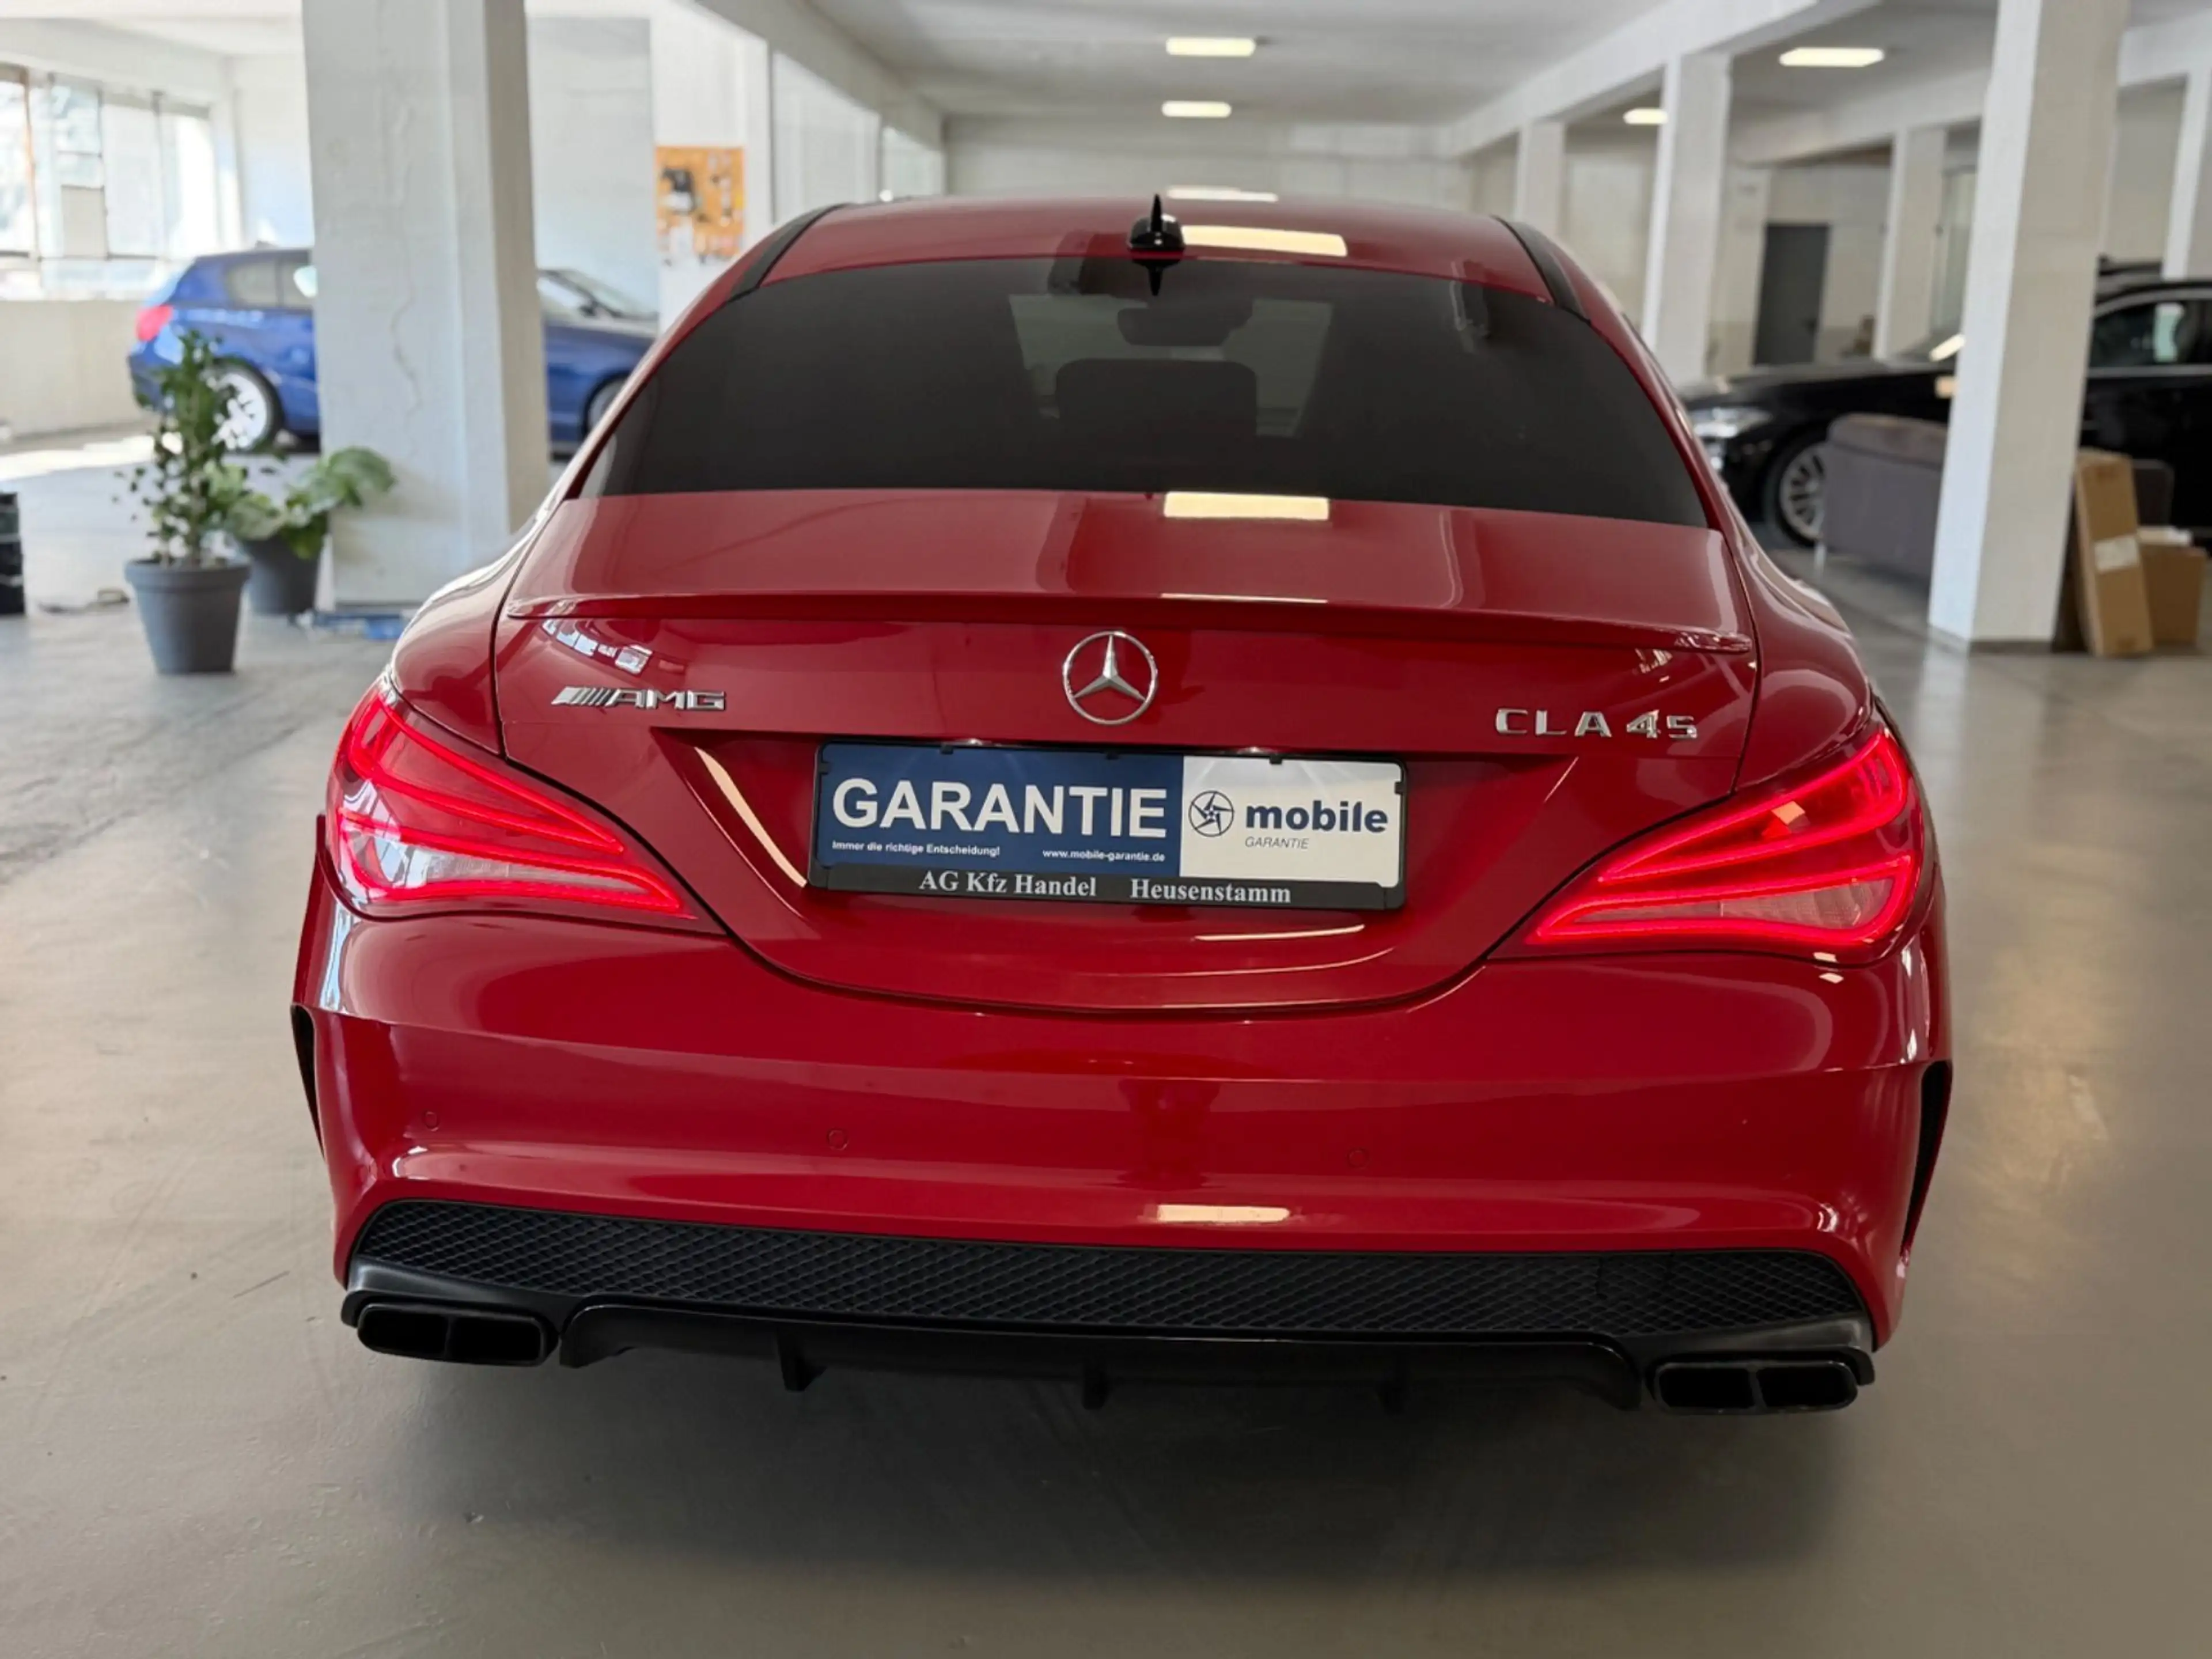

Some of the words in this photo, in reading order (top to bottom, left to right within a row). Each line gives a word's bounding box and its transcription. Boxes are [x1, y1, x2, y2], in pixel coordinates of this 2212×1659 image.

[605, 688, 727, 711] AMG
[1495, 707, 1612, 738] CLA
[1626, 709, 1698, 739] 45
[832, 778, 1167, 838] GARANTIE
[1245, 800, 1388, 833] mobile
[832, 840, 864, 851] Immer
[866, 842, 882, 851] die
[885, 842, 925, 855] richtige
[926, 843, 1000, 858] Entscheidung!
[1042, 849, 1165, 862] www.mobile-garantie.de
[1245, 836, 1309, 850] GARANTIE
[919, 870, 960, 892] AG
[966, 872, 1007, 893] Kfz
[1014, 873, 1097, 896] Handel
[1130, 878, 1291, 903] Heusenstamm
